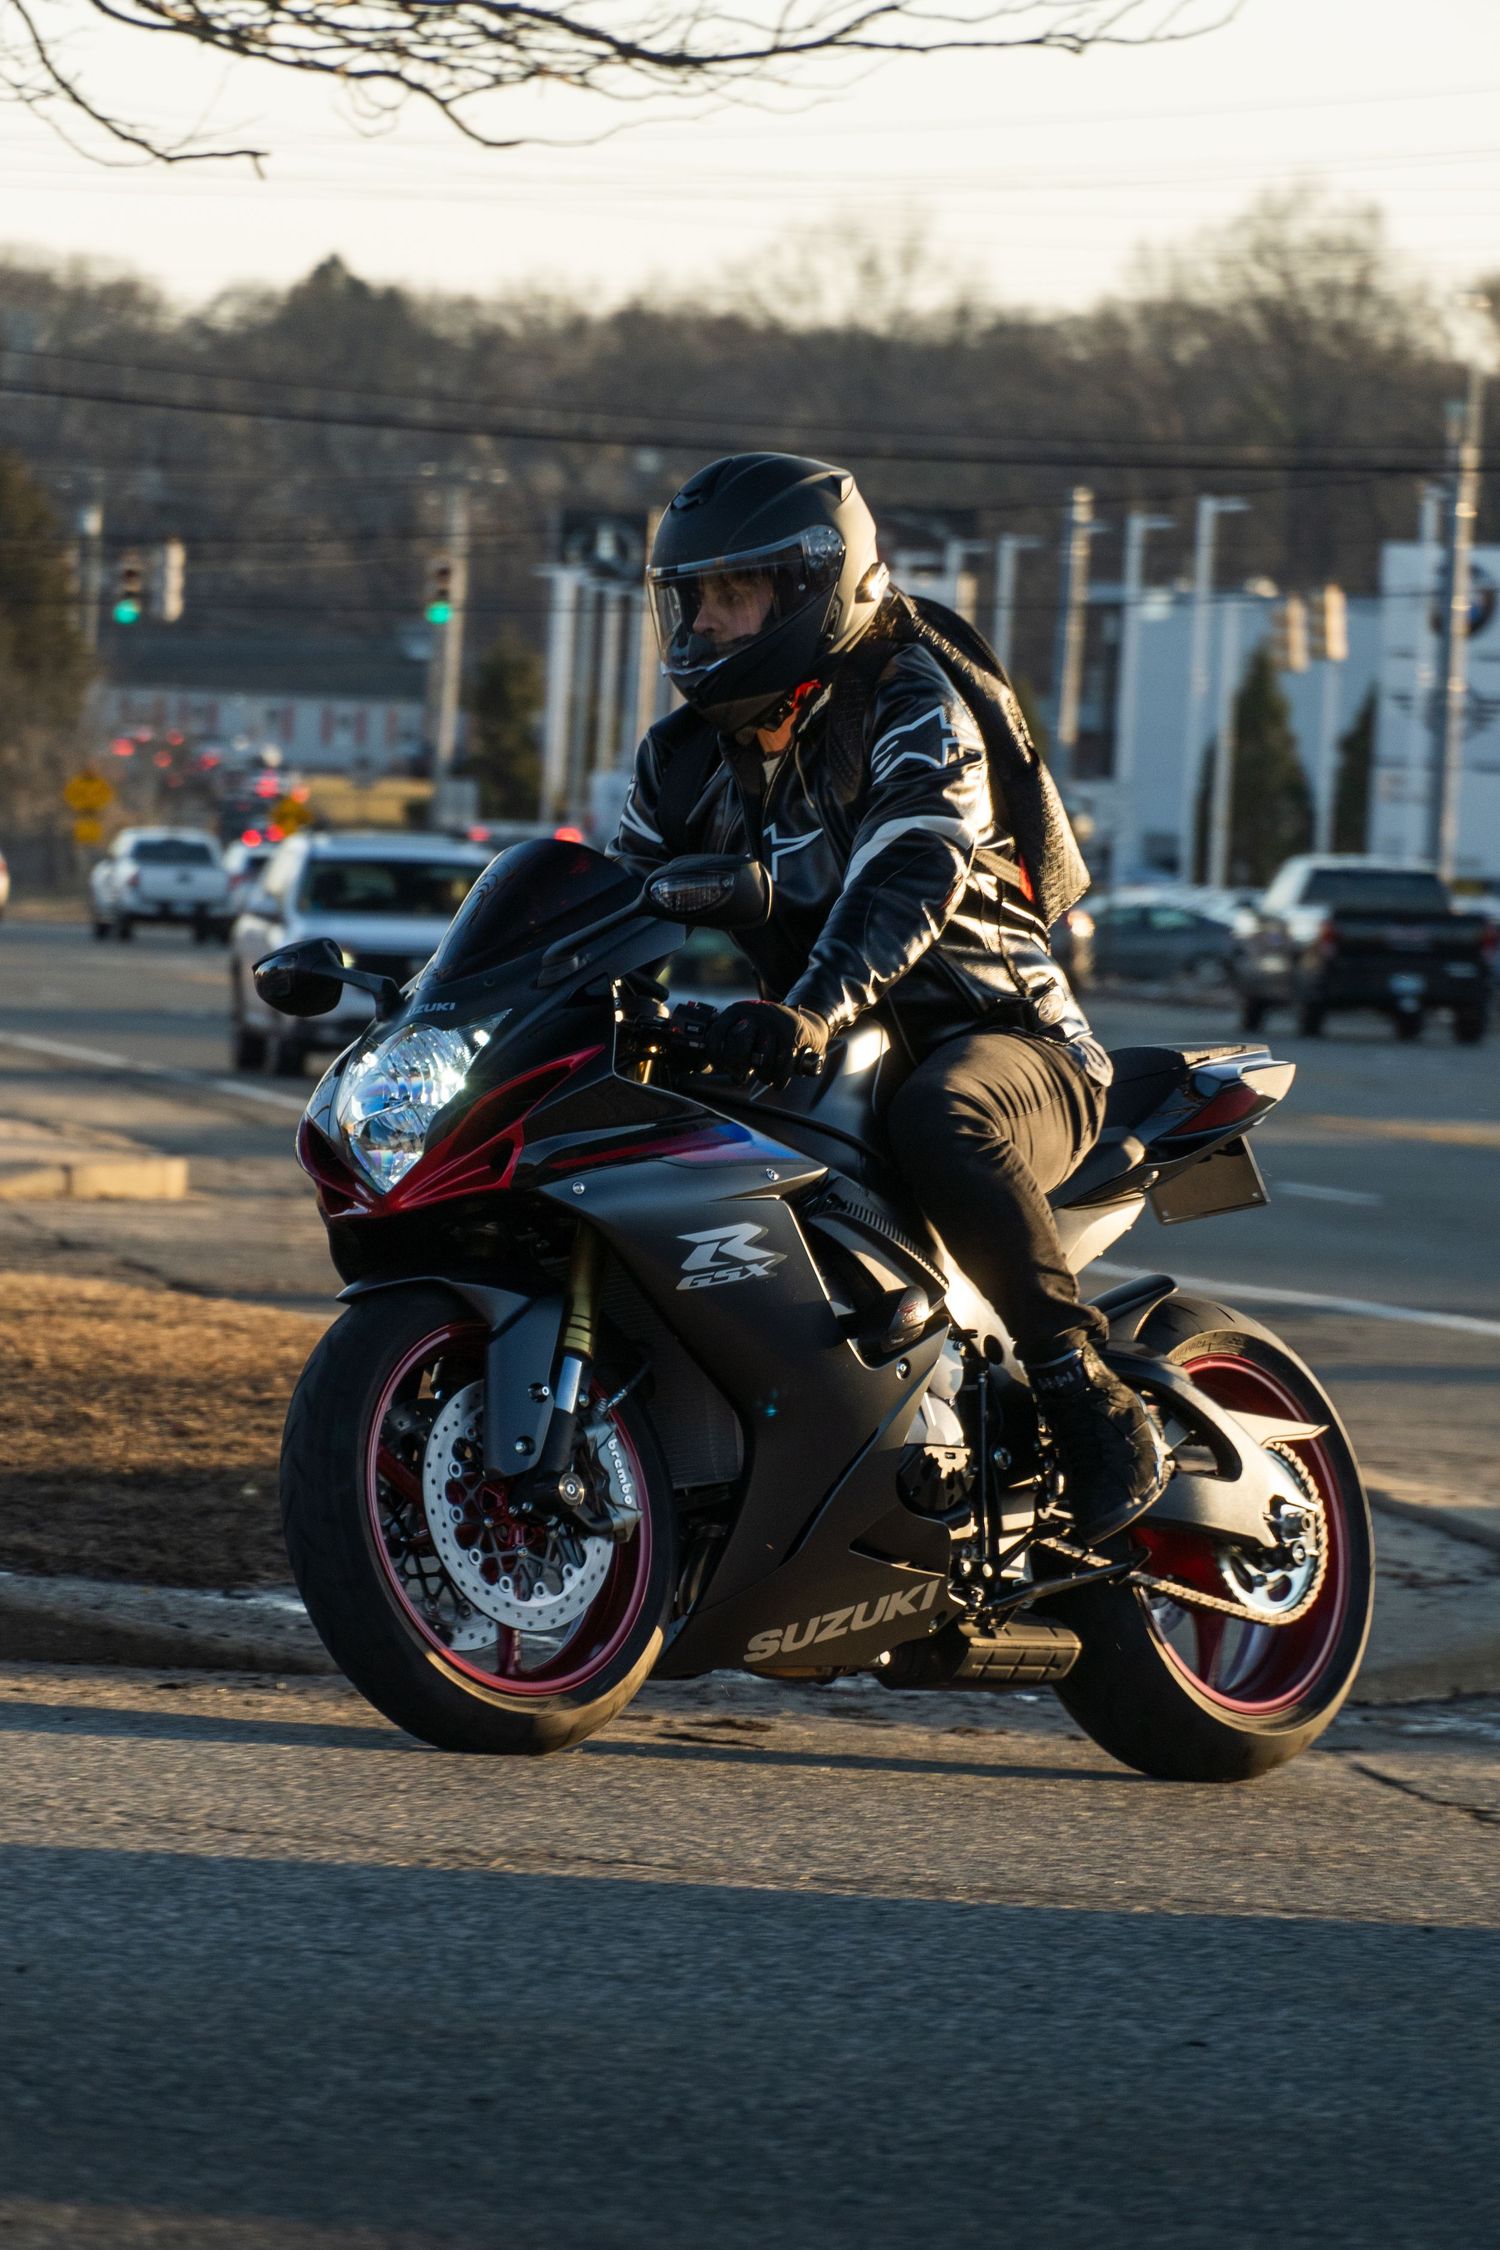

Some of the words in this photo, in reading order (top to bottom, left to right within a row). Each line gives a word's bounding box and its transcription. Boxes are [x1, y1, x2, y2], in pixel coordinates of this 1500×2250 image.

[406, 1002, 456, 1017] UZUKI
[676, 1222, 778, 1271] R
[676, 1259, 777, 1291] GSX
[608, 1439, 633, 1505] brembo
[743, 1579, 940, 1663] SUZUKI
